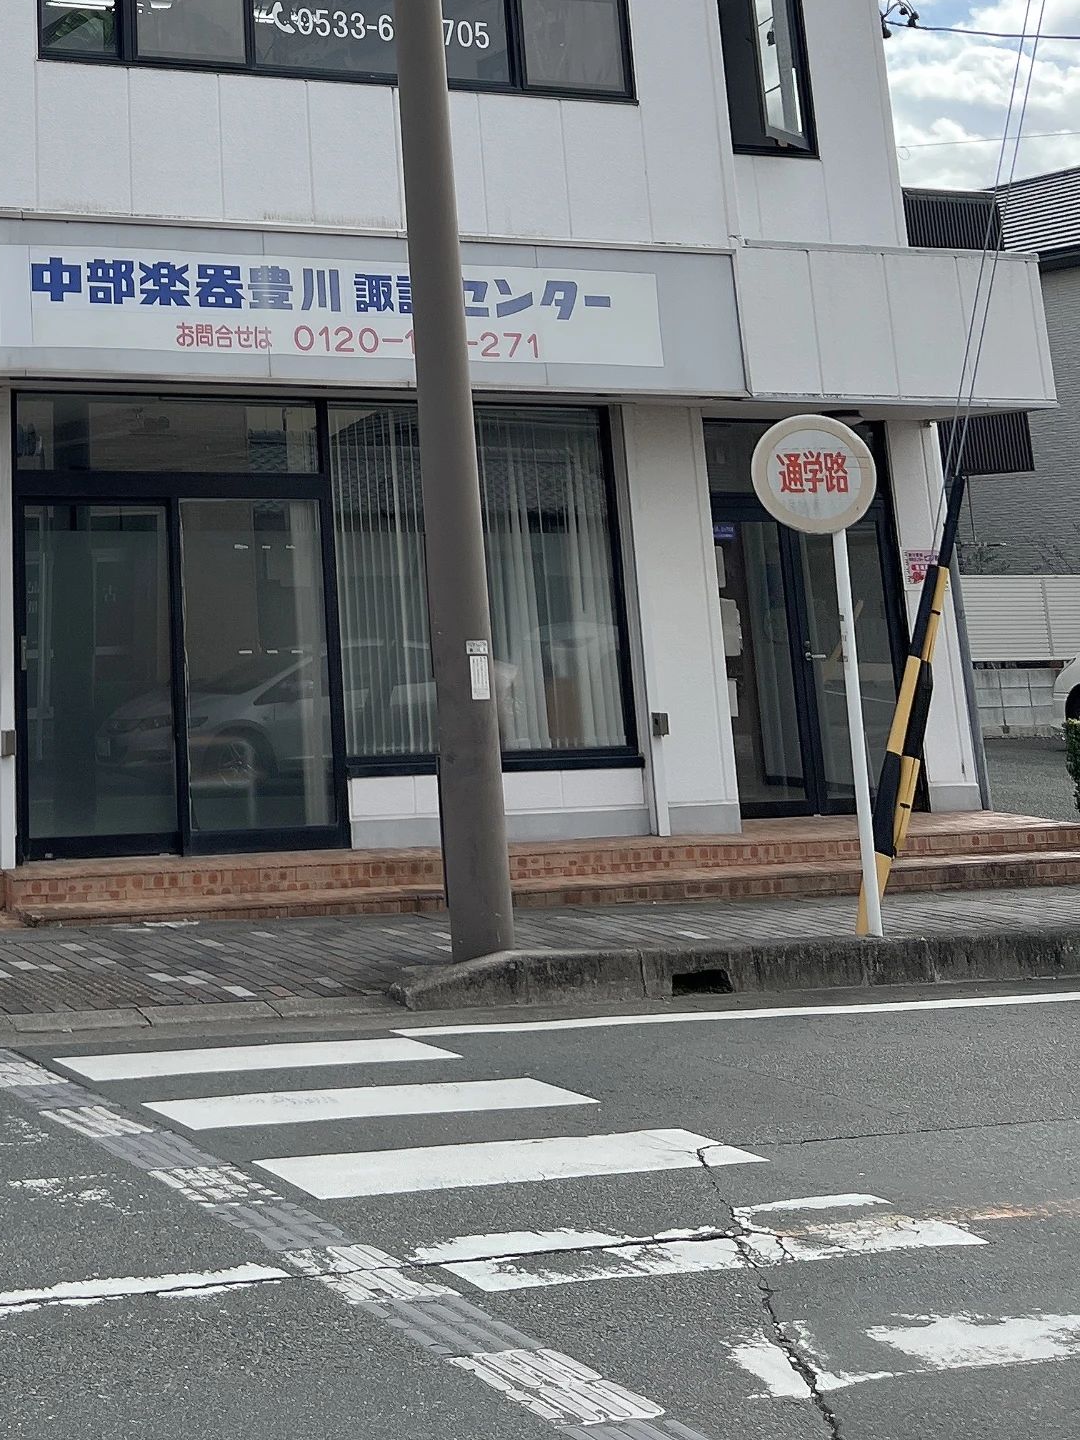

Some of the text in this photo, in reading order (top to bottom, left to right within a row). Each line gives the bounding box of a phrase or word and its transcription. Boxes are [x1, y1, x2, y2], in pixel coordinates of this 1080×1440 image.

[176, 322, 273, 349] お問合せは
[776, 451, 849, 493] 通学路
